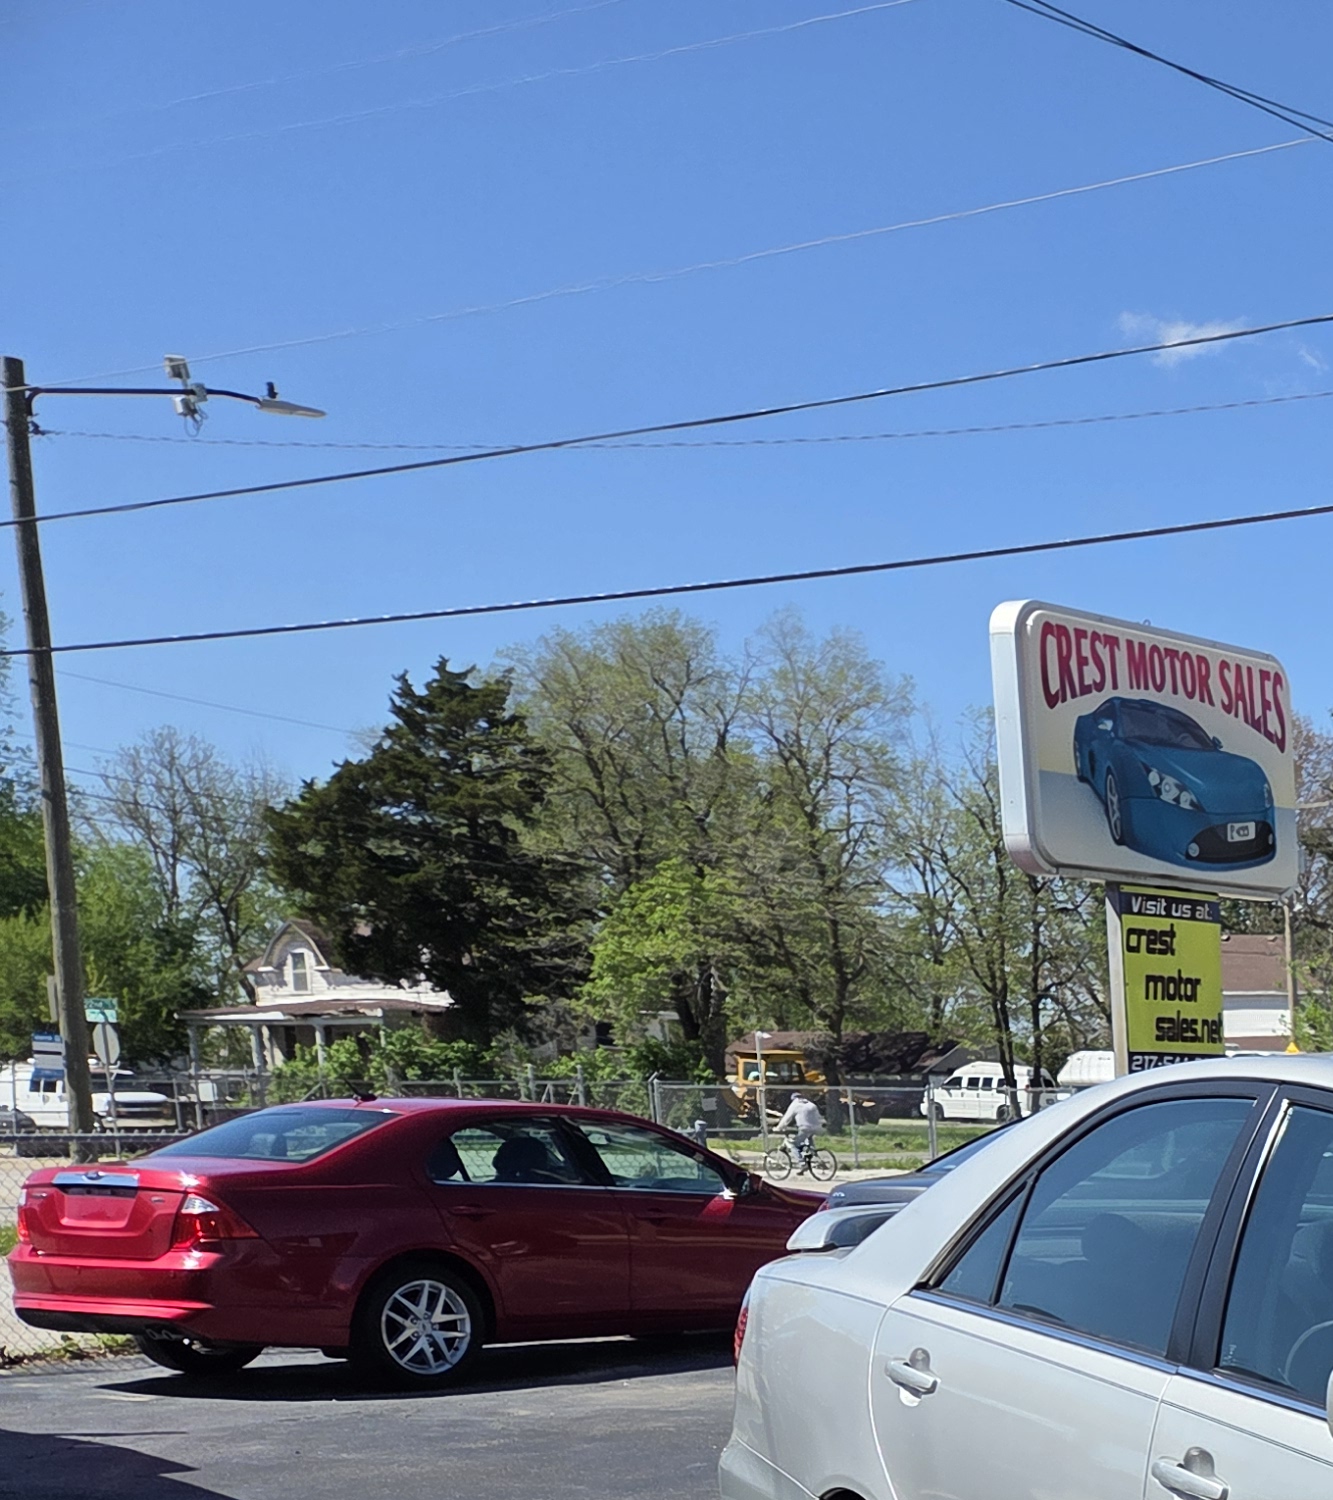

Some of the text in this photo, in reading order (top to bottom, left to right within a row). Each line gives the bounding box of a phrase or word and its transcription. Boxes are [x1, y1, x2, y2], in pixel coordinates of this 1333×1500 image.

[1040, 621, 1286, 754] CREST MOTOR SALES
[1131, 895, 1167, 916] Visit
[1171, 902, 1192, 917] us
[1126, 922, 1176, 957] crest
[1145, 968, 1202, 1003] motor
[1155, 1009, 1223, 1044] sales.net
